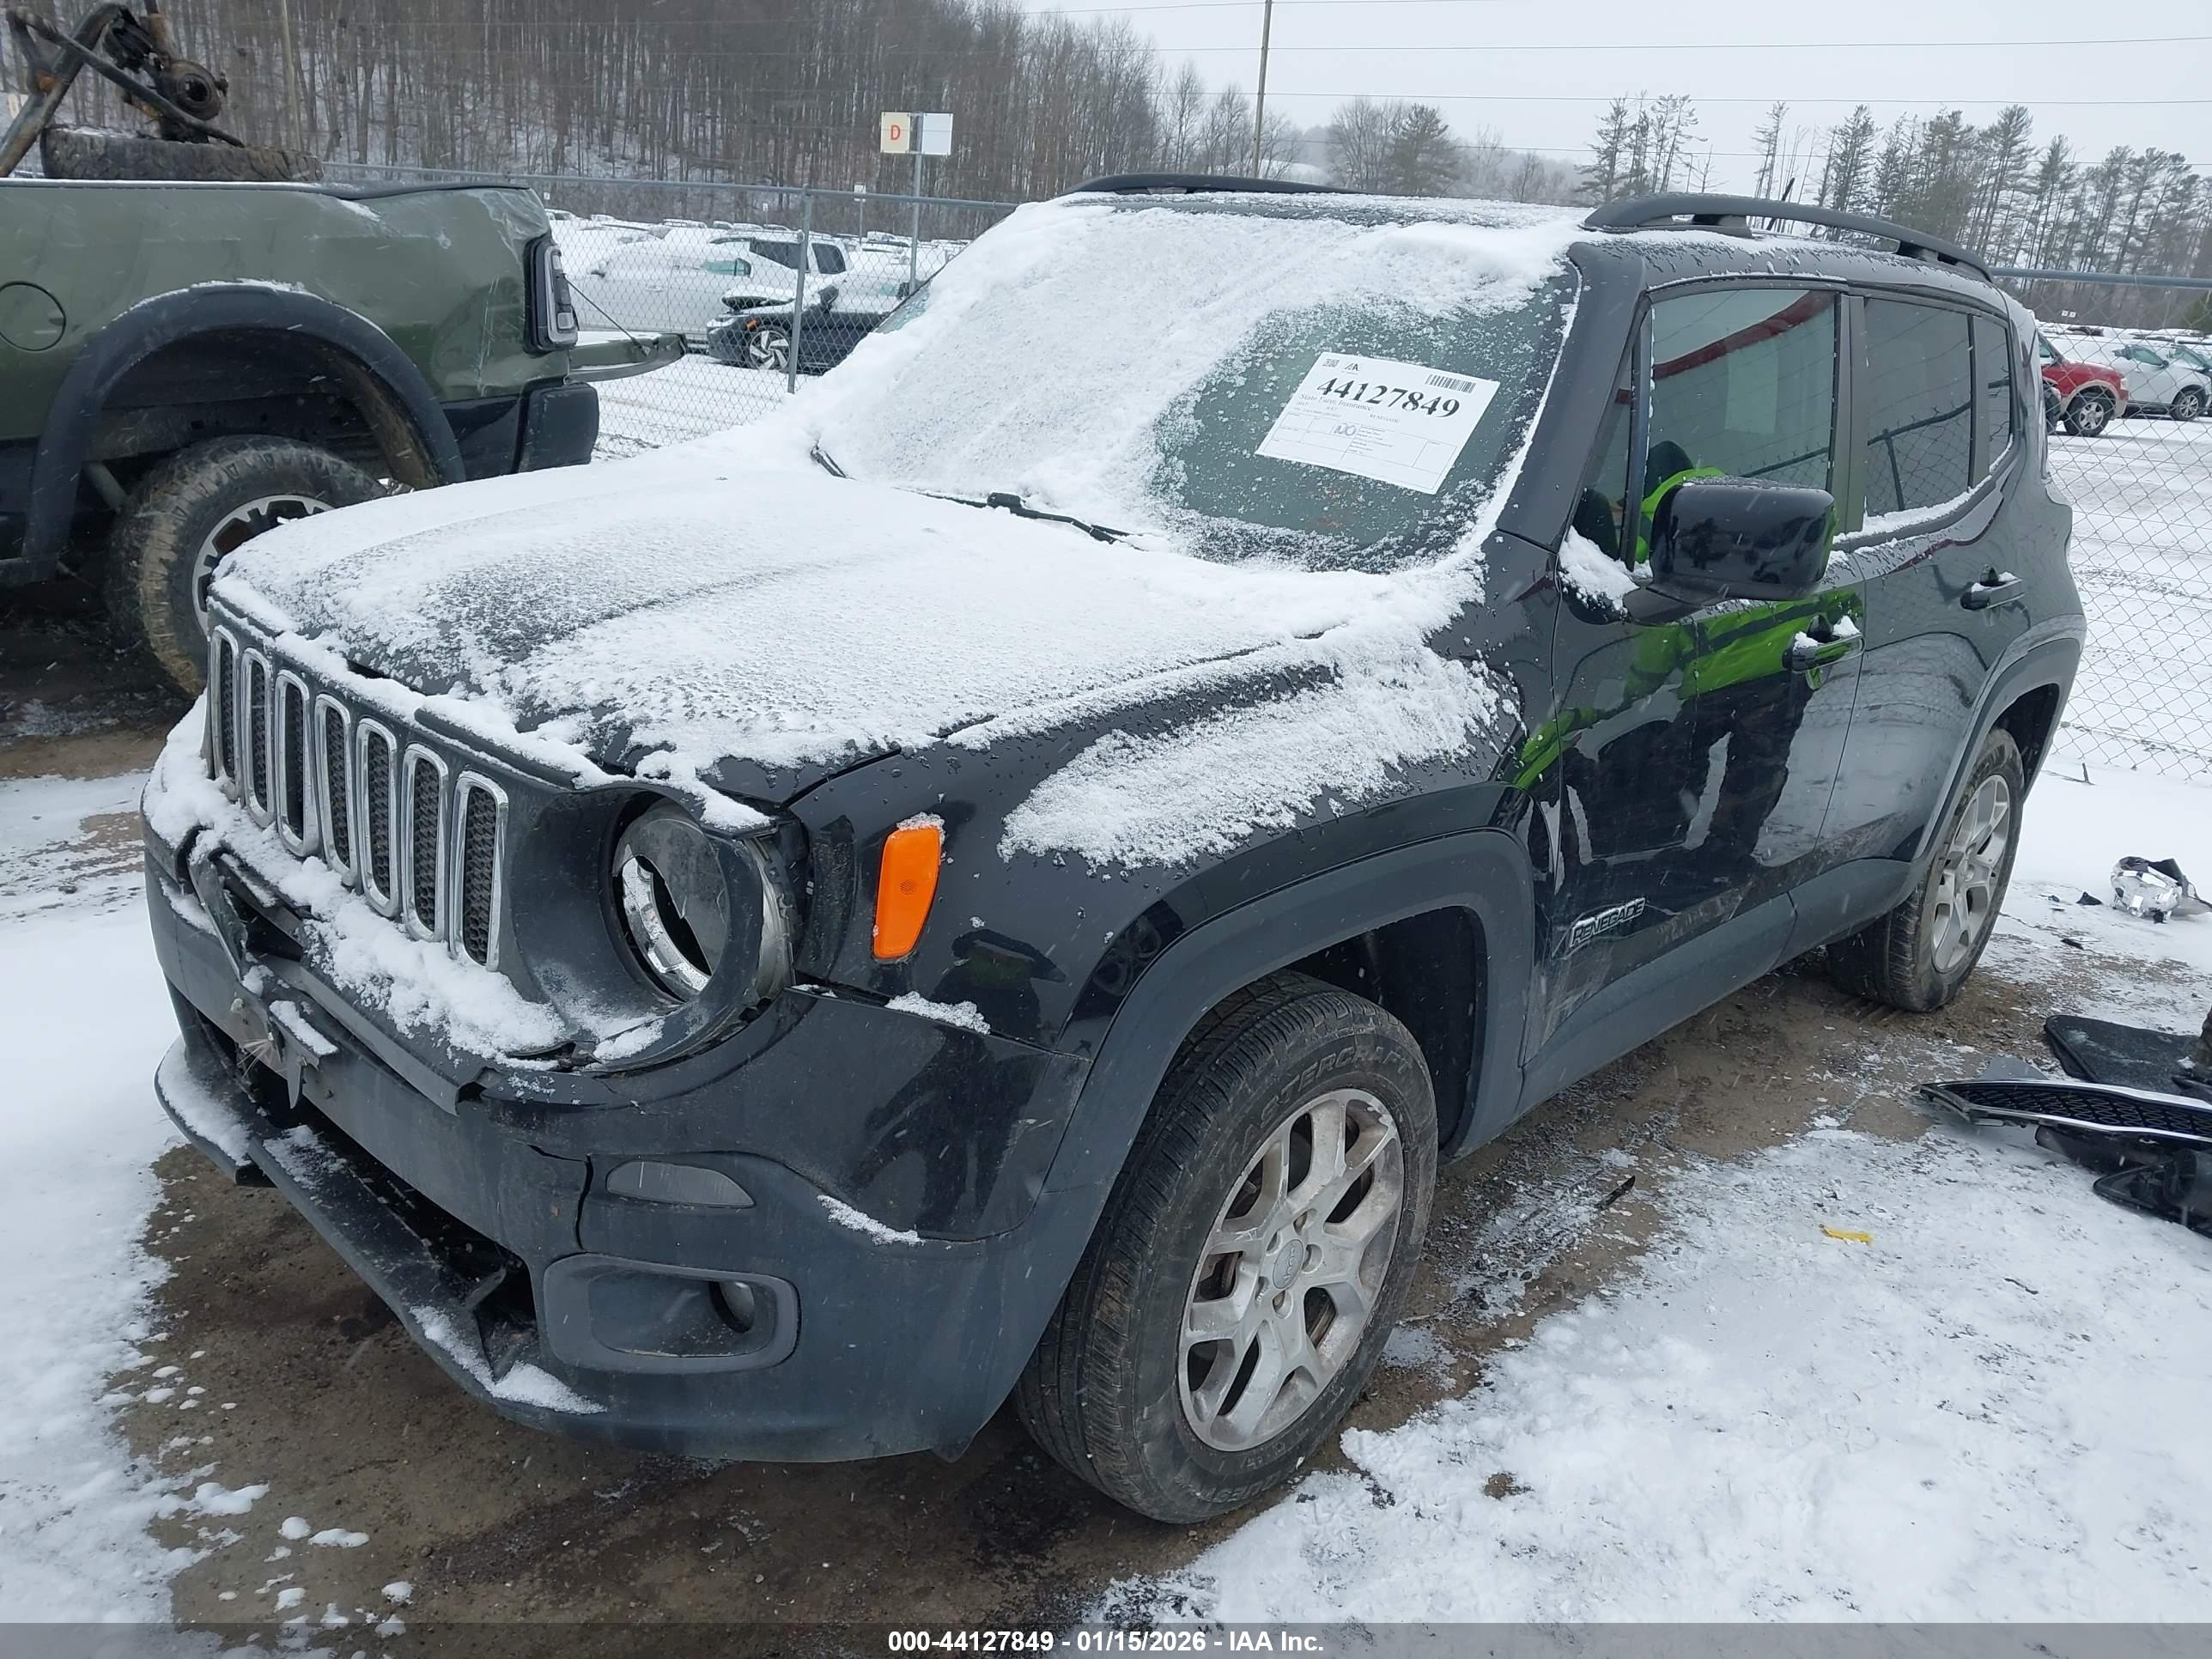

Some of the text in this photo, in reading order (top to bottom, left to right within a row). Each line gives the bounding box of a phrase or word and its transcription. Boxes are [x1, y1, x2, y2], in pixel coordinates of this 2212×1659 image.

[890, 125, 901, 140] D
[1316, 377, 1460, 418] 44127849
[1338, 398, 1373, 411] Insurance
[1570, 897, 1646, 947] RENEGADE
